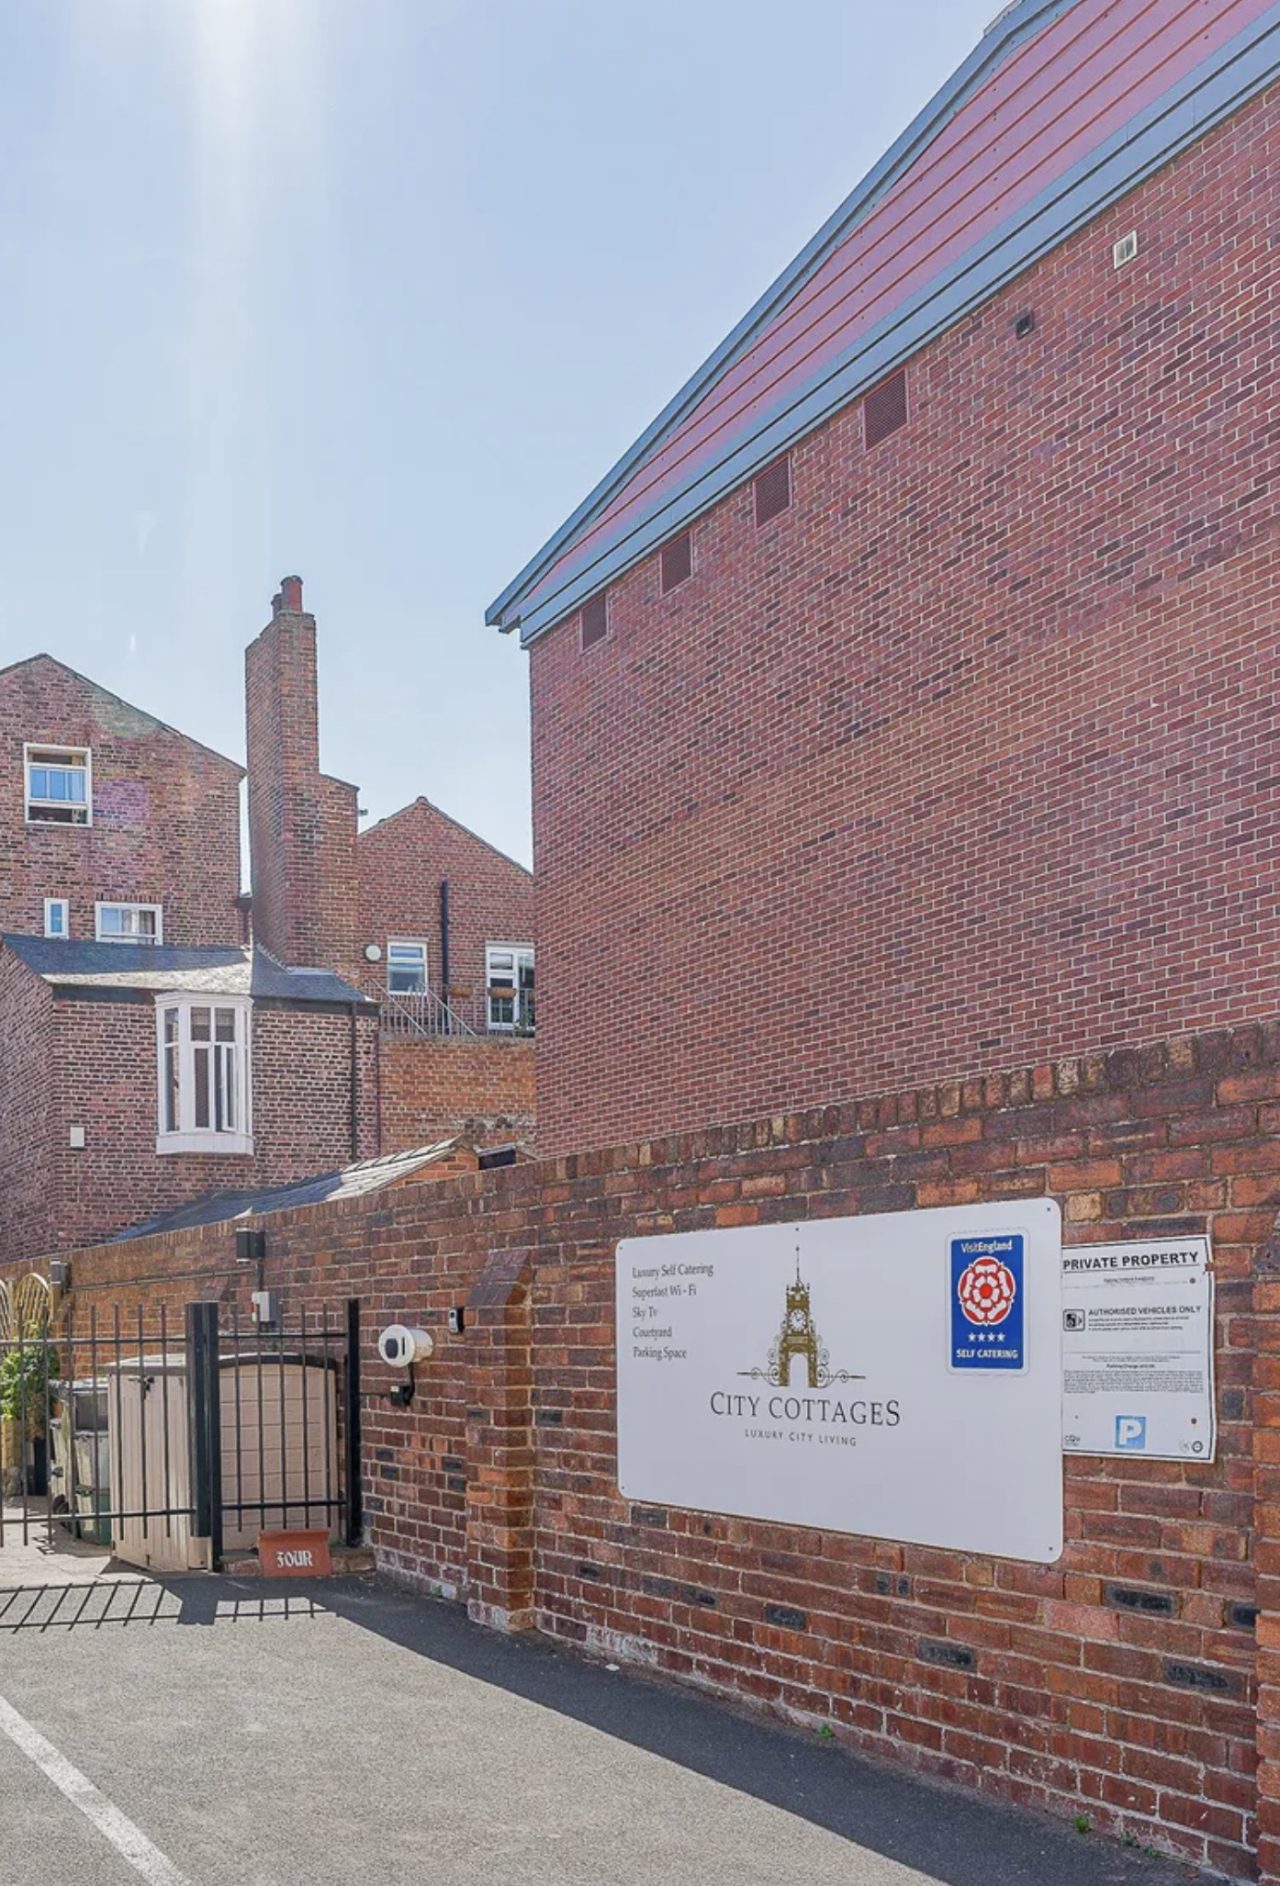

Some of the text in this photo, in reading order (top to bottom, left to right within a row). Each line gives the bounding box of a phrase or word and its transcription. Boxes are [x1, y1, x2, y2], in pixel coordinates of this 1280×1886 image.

[961, 1240, 1013, 1254] VisitEngland
[1063, 1251, 1199, 1270] PRIVATE PROPERTY
[632, 1263, 714, 1280] Luxury Self Catering
[632, 1285, 668, 1301] Superfast
[632, 1306, 646, 1320] Sky
[1088, 1305, 1201, 1316] AUTHORISED VEHICLES ONLY
[632, 1325, 672, 1341] Courtyard
[633, 1345, 687, 1361] Parking Space
[956, 1347, 1018, 1360] SELF CATERING
[710, 1391, 900, 1427] CITY COTTAGES
[745, 1428, 857, 1448] LUXURY CITY LIVING
[276, 1550, 313, 1569] FOUR
